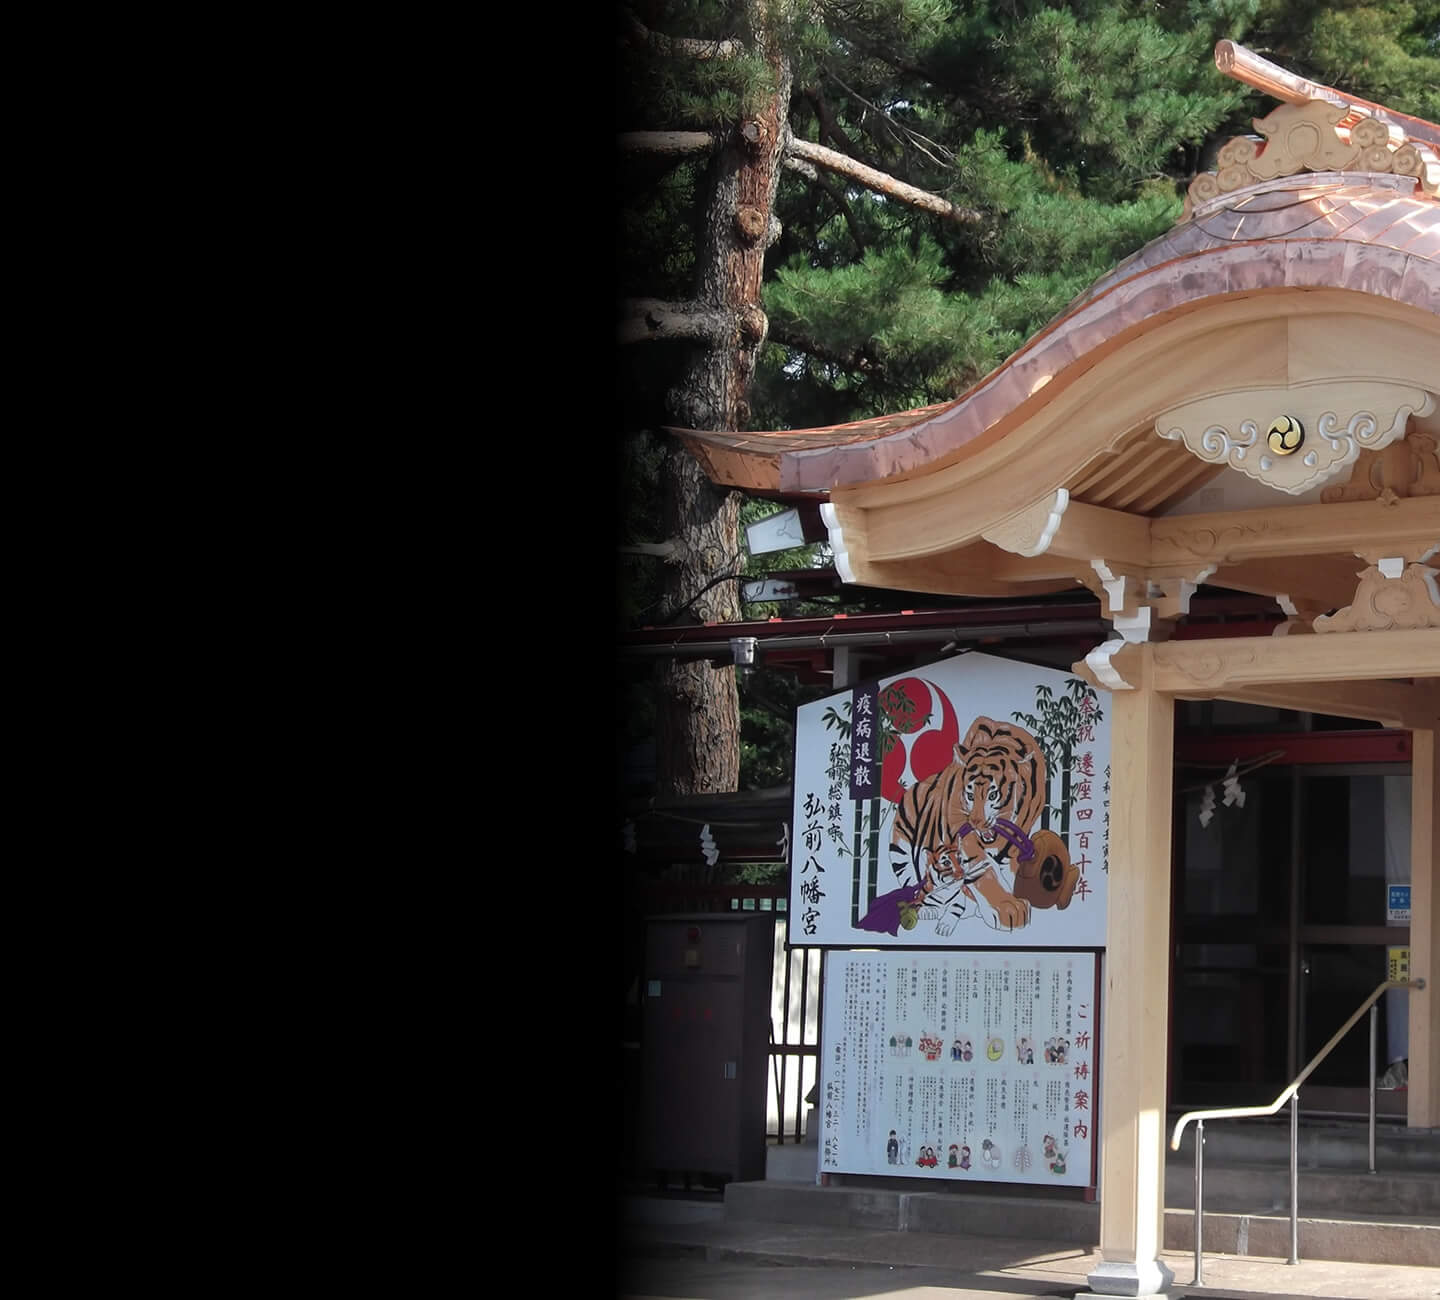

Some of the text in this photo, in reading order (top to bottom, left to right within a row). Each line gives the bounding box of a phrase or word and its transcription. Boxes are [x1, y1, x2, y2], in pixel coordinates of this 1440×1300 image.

[853, 694, 873, 787] 疫病退散
[800, 792, 826, 936] 弘前八幡宮
[1072, 1003, 1091, 1140] ご祈祷案内
